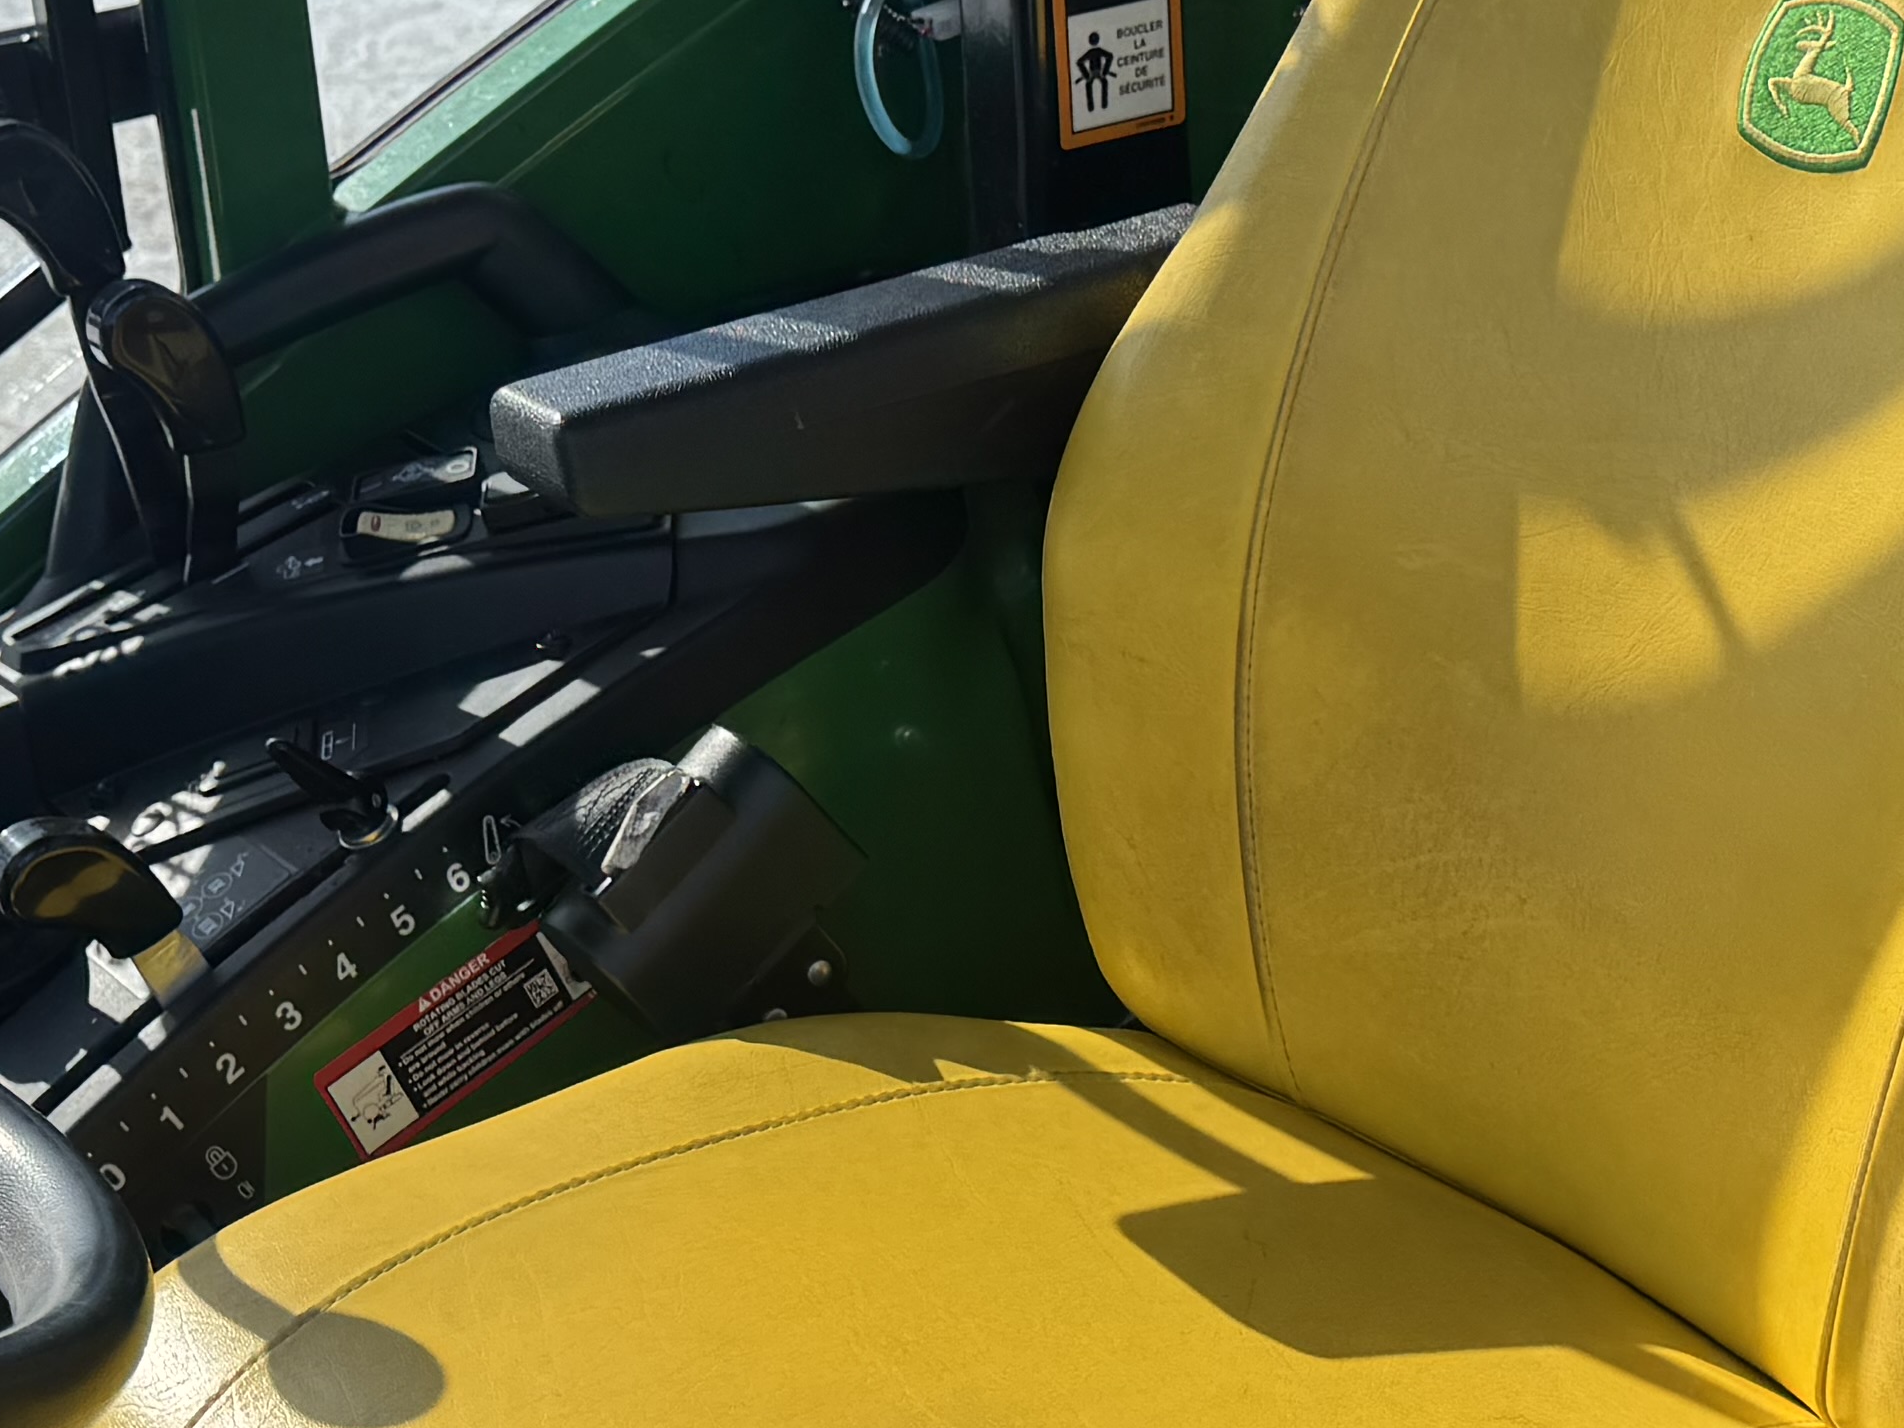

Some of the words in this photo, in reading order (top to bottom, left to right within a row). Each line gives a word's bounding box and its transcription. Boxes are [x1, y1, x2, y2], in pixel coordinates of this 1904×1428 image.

[1116, 19, 1164, 40] BOUCLER
[1133, 38, 1147, 50] LA
[1116, 47, 1164, 68] CEINTURE
[1134, 65, 1148, 78] DE
[1118, 73, 1166, 96] SÉCURITÉ
[429, 953, 490, 1002] DANGER
[159, 1106, 184, 1130] 1
[215, 1052, 245, 1084] 2
[275, 1001, 302, 1031] 3
[336, 952, 358, 981] 4
[389, 905, 416, 936] 5
[446, 862, 471, 893] 6
[412, 997, 456, 1032] ROTATING
[455, 973, 490, 1001] BLADES
[488, 959, 506, 976] CUT
[423, 1019, 440, 1037] OFF
[441, 1002, 466, 1026] ARMS
[466, 987, 484, 1006] AND
[483, 971, 507, 994] LEGS
[402, 1054, 414, 1066] Do
[414, 1044, 428, 1057] not
[412, 1070, 425, 1082] Do
[424, 1059, 438, 1073] not
